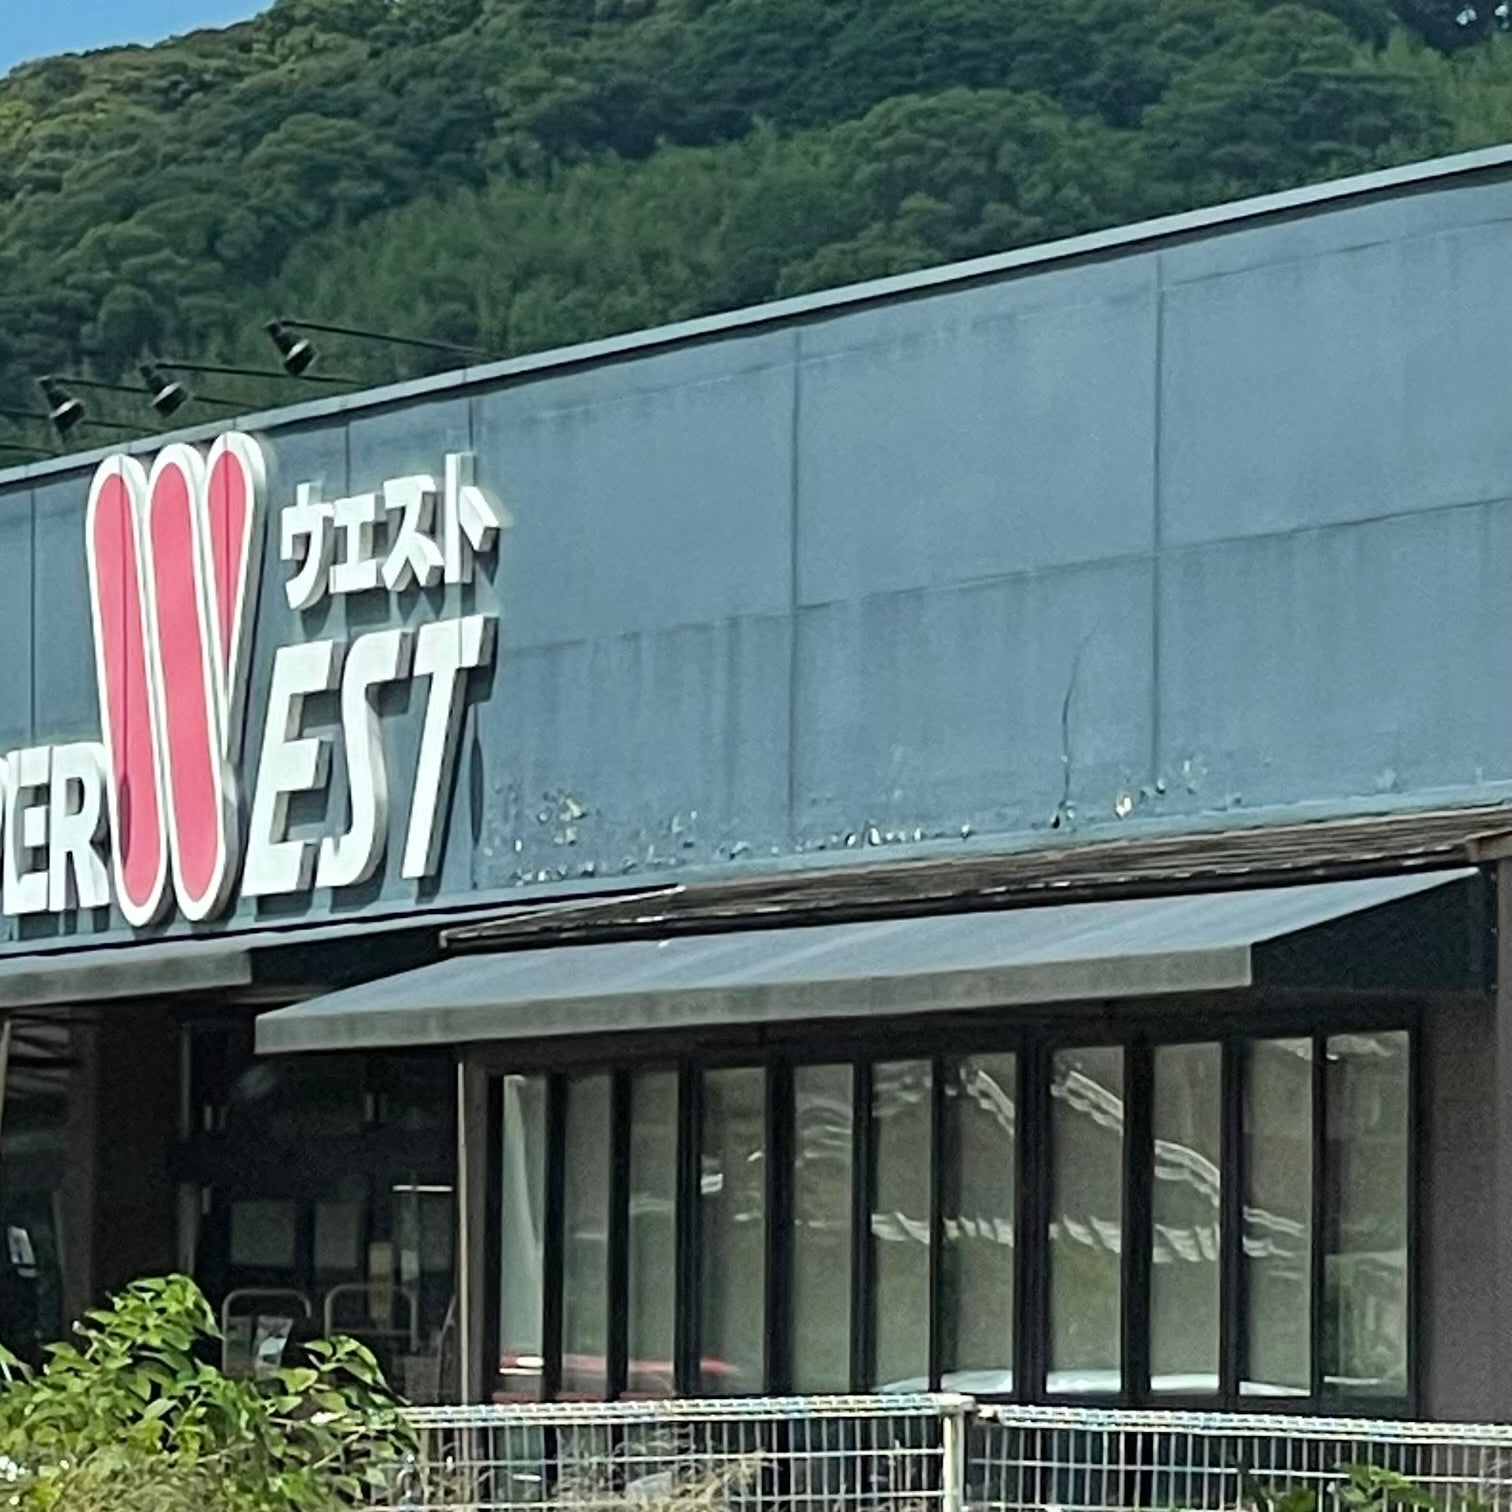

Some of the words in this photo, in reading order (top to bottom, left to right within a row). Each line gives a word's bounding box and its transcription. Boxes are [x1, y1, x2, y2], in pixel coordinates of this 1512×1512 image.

[86, 431, 491, 927] WEST
[280, 451, 500, 610] ウエスト
